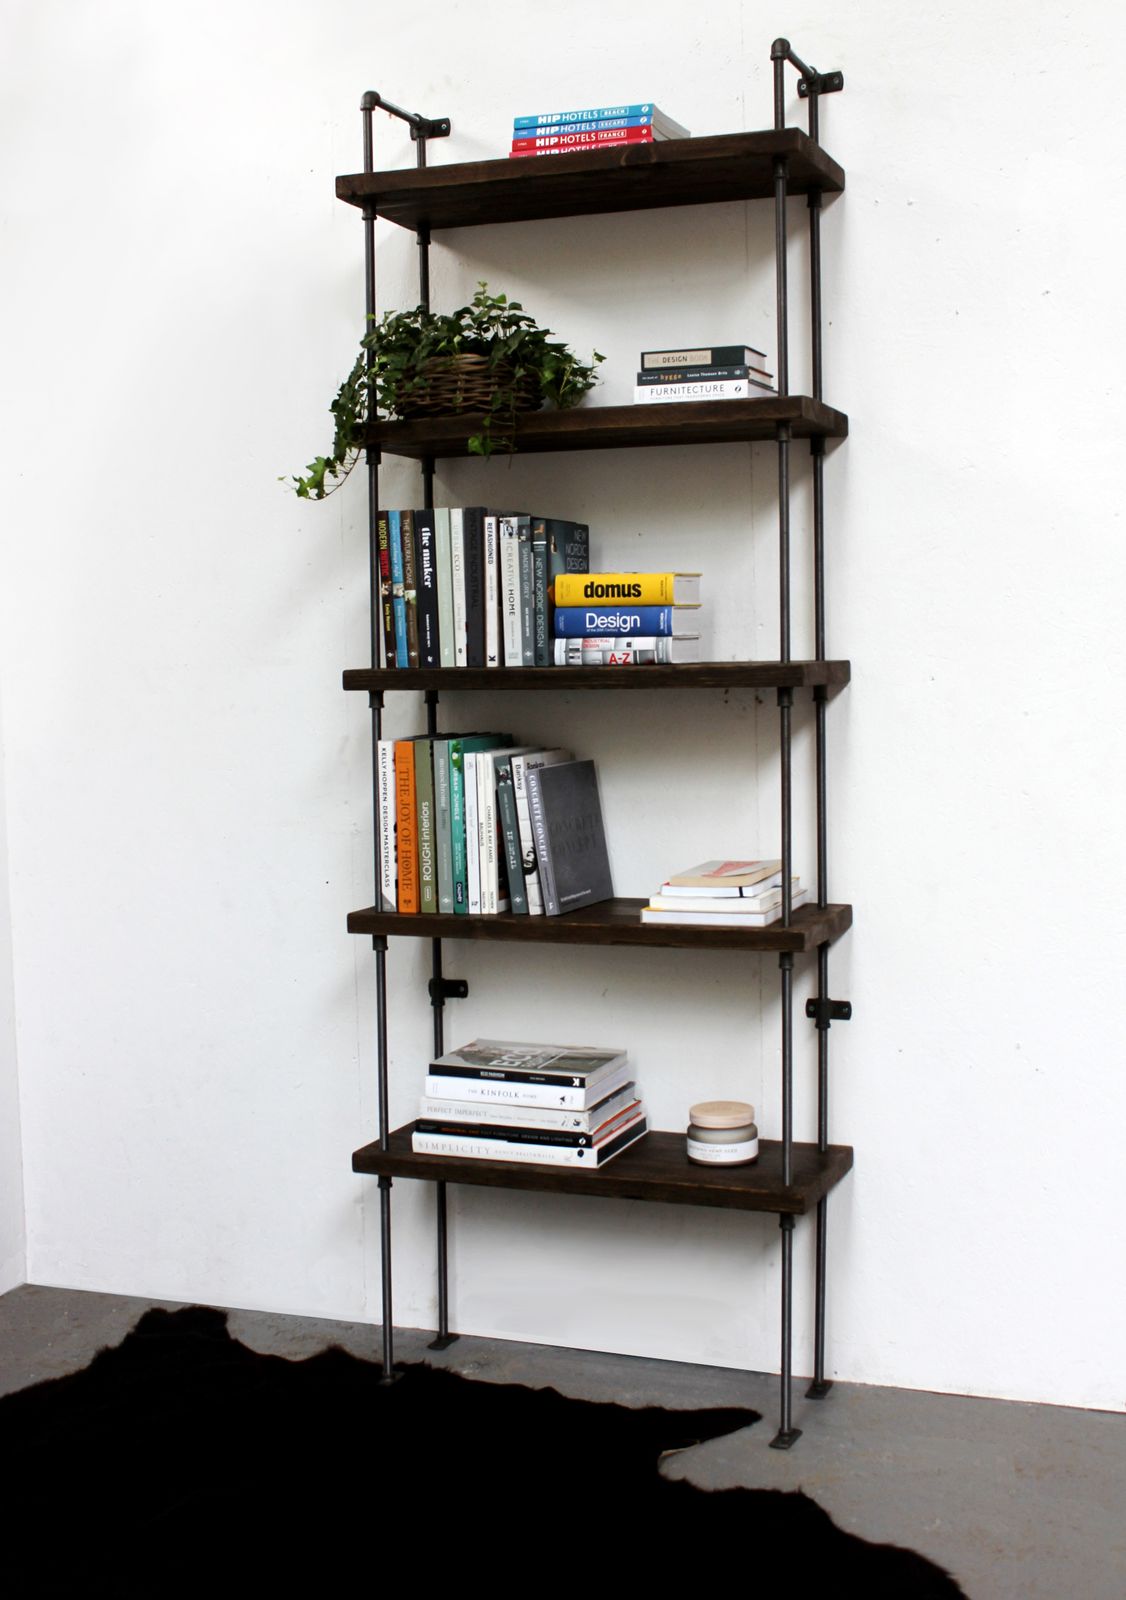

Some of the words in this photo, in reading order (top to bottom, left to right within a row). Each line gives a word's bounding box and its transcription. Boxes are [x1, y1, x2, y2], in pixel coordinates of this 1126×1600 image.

[538, 115, 560, 124] HIP
[562, 111, 598, 122] HOTELS
[536, 126, 560, 135] HIP
[562, 122, 596, 132] HOTELS
[600, 120, 626, 128] ESCAPE
[536, 138, 558, 147] HIP
[560, 133, 596, 144] HOTELS
[600, 131, 625, 139] FRANCE
[650, 384, 725, 395] FURNITECTURE
[379, 520, 387, 549] MODERN
[421, 527, 431, 546] the
[469, 510, 478, 551] VINTAGE
[574, 530, 586, 541] NEW
[566, 543, 587, 556] NORDIC
[422, 549, 433, 588] maker
[506, 546, 514, 586] CREATIVE
[567, 557, 587, 570] DESIGN
[405, 563, 413, 584] HOME
[471, 553, 479, 609] INDUSTRIAL
[584, 582, 642, 598] domus
[586, 613, 640, 632] Design
[609, 652, 630, 664] A-Z
[399, 768, 410, 797] THE
[400, 799, 410, 825] JOY
[421, 801, 430, 840] interiors
[529, 775, 542, 820] CONCRETE
[536, 822, 547, 862] CONCEPT
[401, 828, 412, 846] OF
[401, 850, 413, 891] HOME
[422, 843, 431, 881] ROUGH
[480, 1087, 520, 1098] KINFOLK
[426, 1106, 452, 1114] PERFECT
[454, 1107, 487, 1116] IMPERFECT
[418, 1141, 490, 1155] SIMPLICITY
